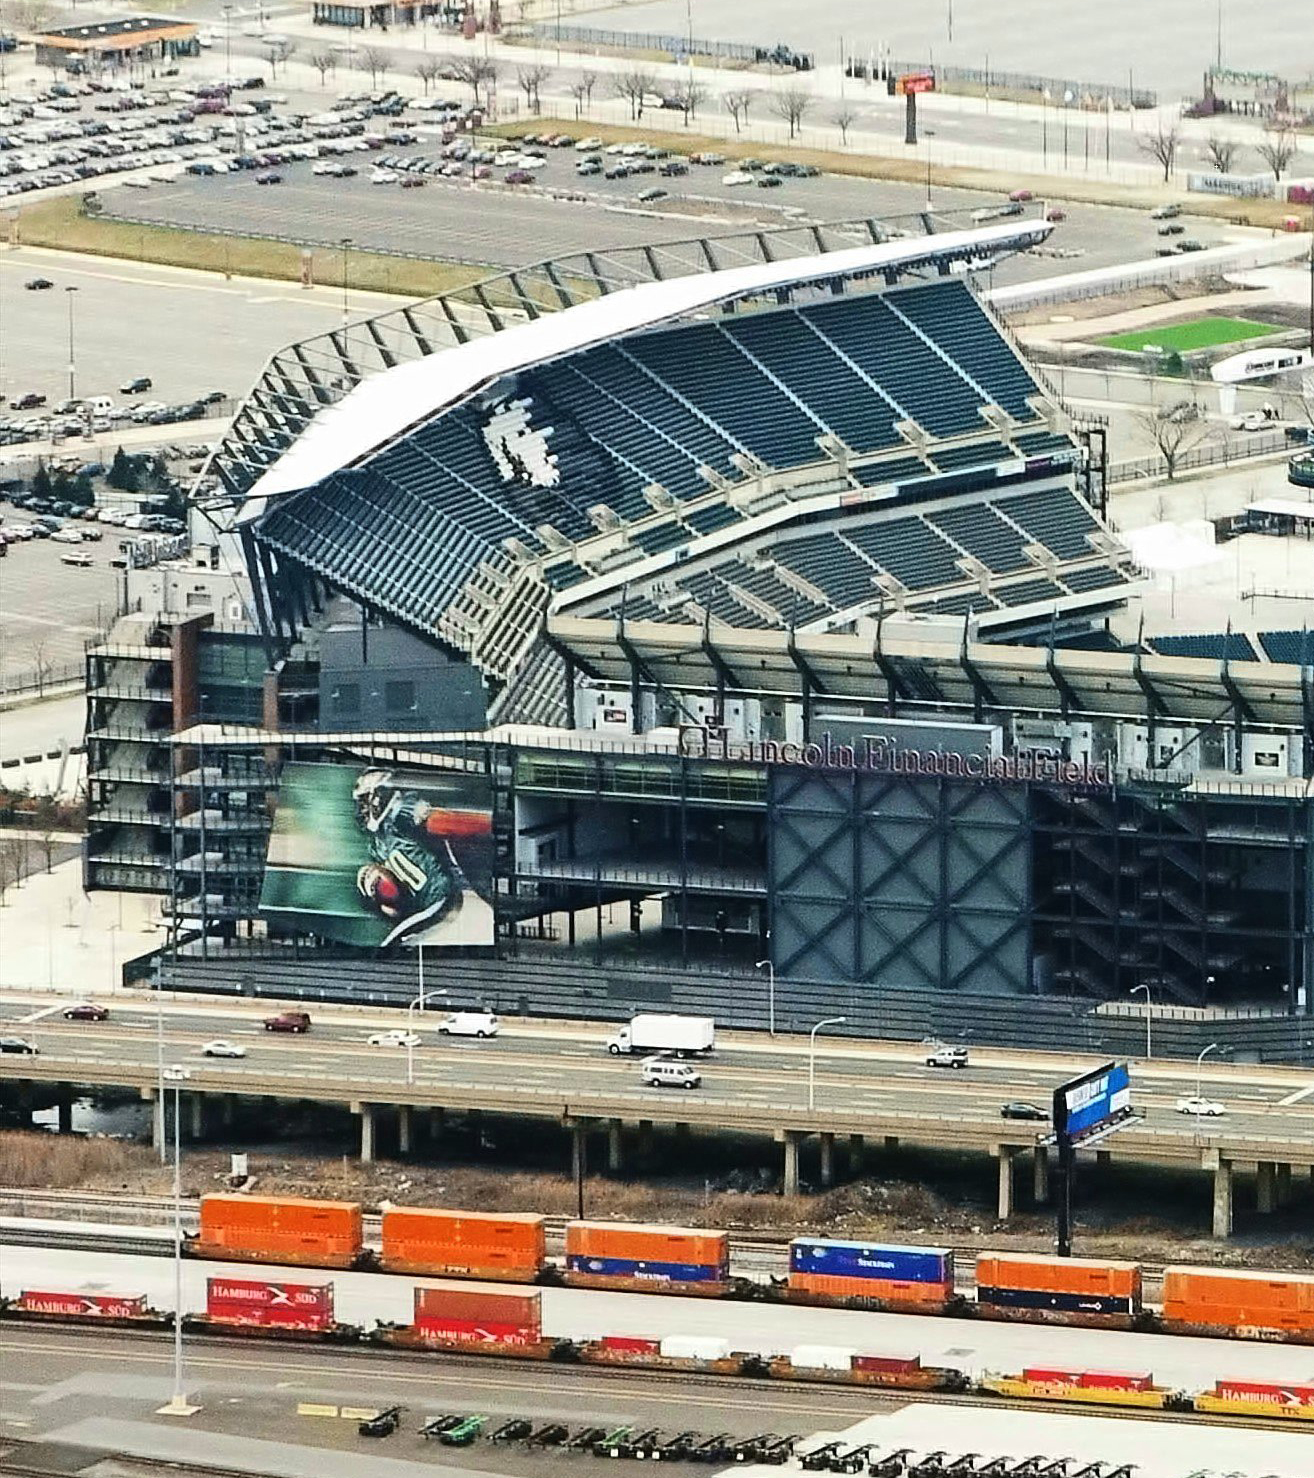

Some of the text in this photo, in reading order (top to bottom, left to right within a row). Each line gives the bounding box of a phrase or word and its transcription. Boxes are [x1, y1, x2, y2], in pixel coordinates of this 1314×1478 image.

[719, 725, 1113, 785] Lincoln Financial Field
[212, 1285, 268, 1300] HAMBURG
[26, 1298, 80, 1314] HAMBURG
[1222, 1388, 1280, 1405] HAMBURG
[1281, 1406, 1300, 1416] TTX
